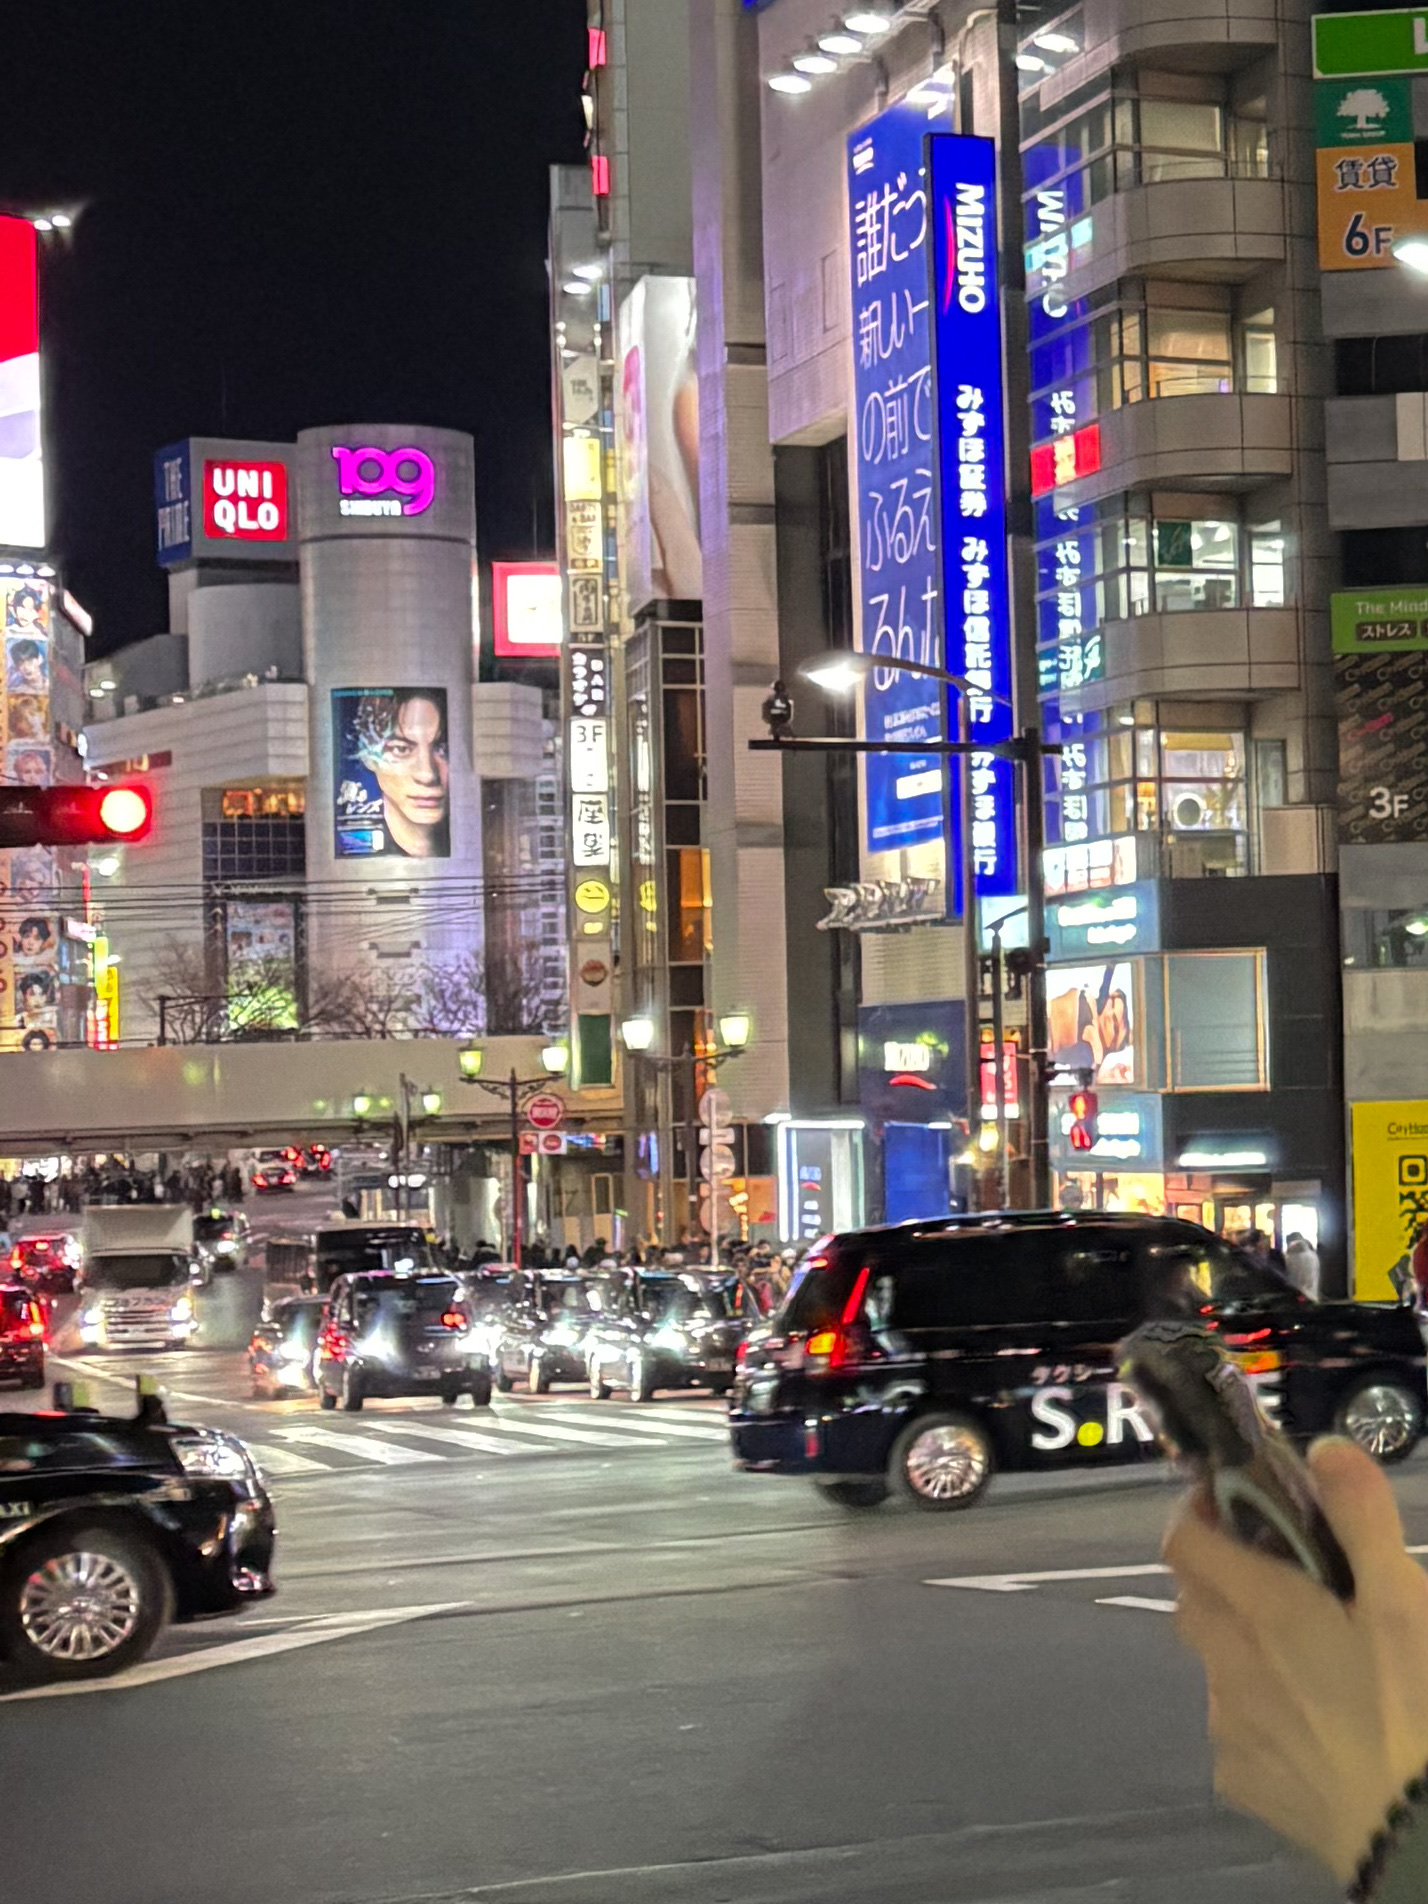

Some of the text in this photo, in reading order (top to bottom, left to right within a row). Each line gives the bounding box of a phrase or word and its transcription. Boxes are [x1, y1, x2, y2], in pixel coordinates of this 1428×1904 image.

[1334, 155, 1399, 192] 賃貸
[955, 182, 985, 314] MIZUHO
[1344, 212, 1394, 257] 6F
[955, 384, 988, 519] みずほ証券
[213, 467, 273, 500] UNI
[331, 446, 435, 517] 109
[213, 499, 280, 534] QLO
[1356, 601, 1385, 615] The
[1361, 622, 1412, 639] ストレス
[576, 724, 604, 744] 3F
[1368, 787, 1410, 820] 3F
